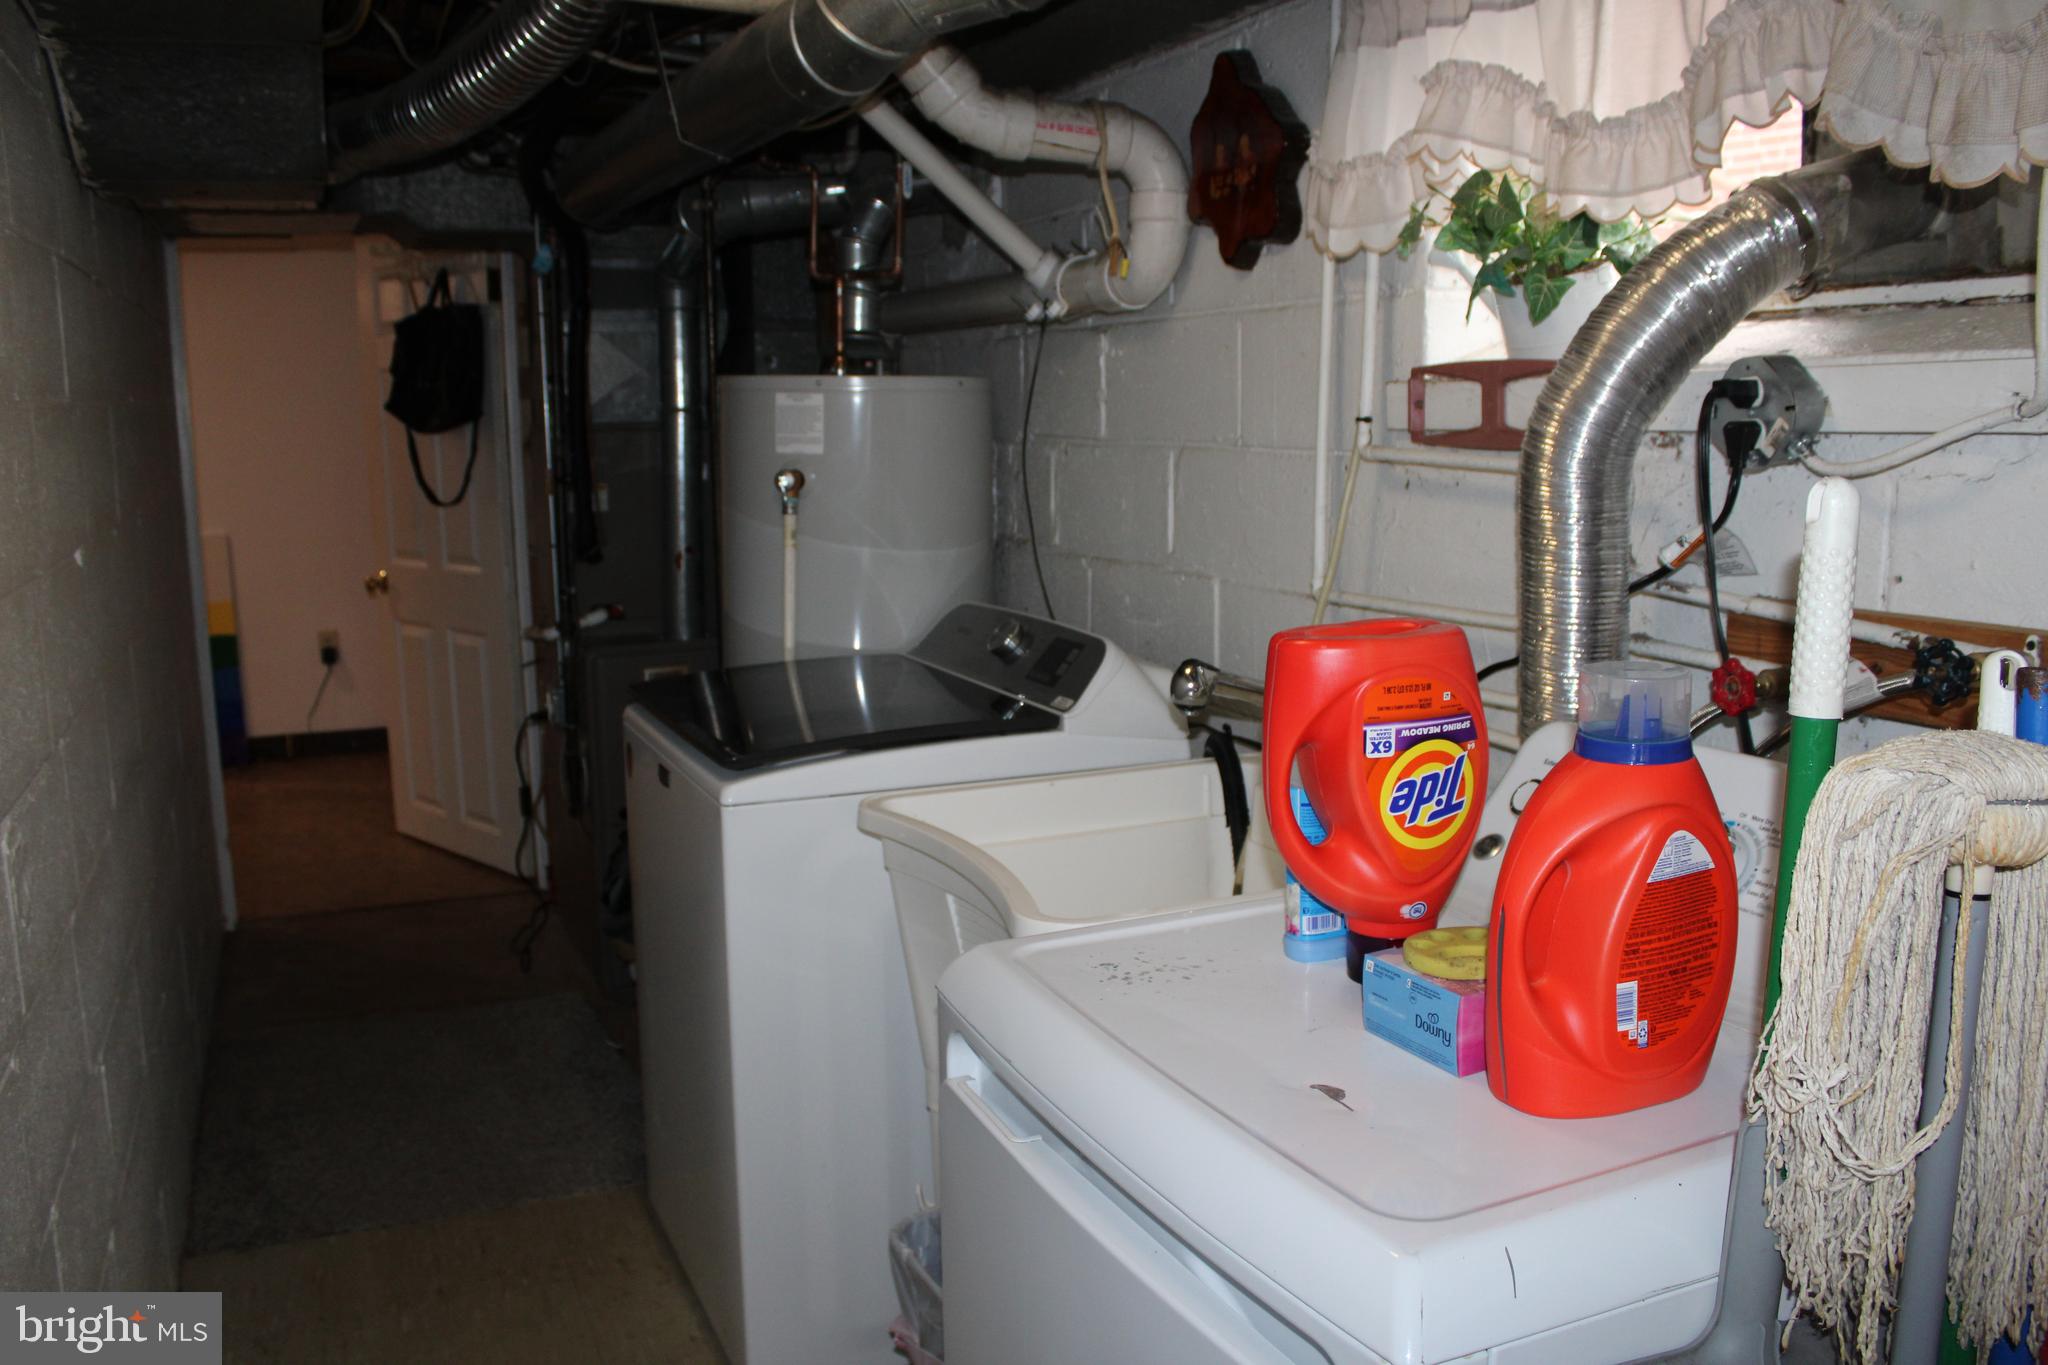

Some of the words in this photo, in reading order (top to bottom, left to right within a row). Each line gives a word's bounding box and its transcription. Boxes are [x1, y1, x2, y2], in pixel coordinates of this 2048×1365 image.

[1401, 725, 1441, 737] MEADOW
[1442, 720, 1471, 732] SPRING
[1370, 740, 1392, 754] 6X
[1388, 751, 1467, 828] Tide
[1415, 1014, 1452, 1047] Downy
